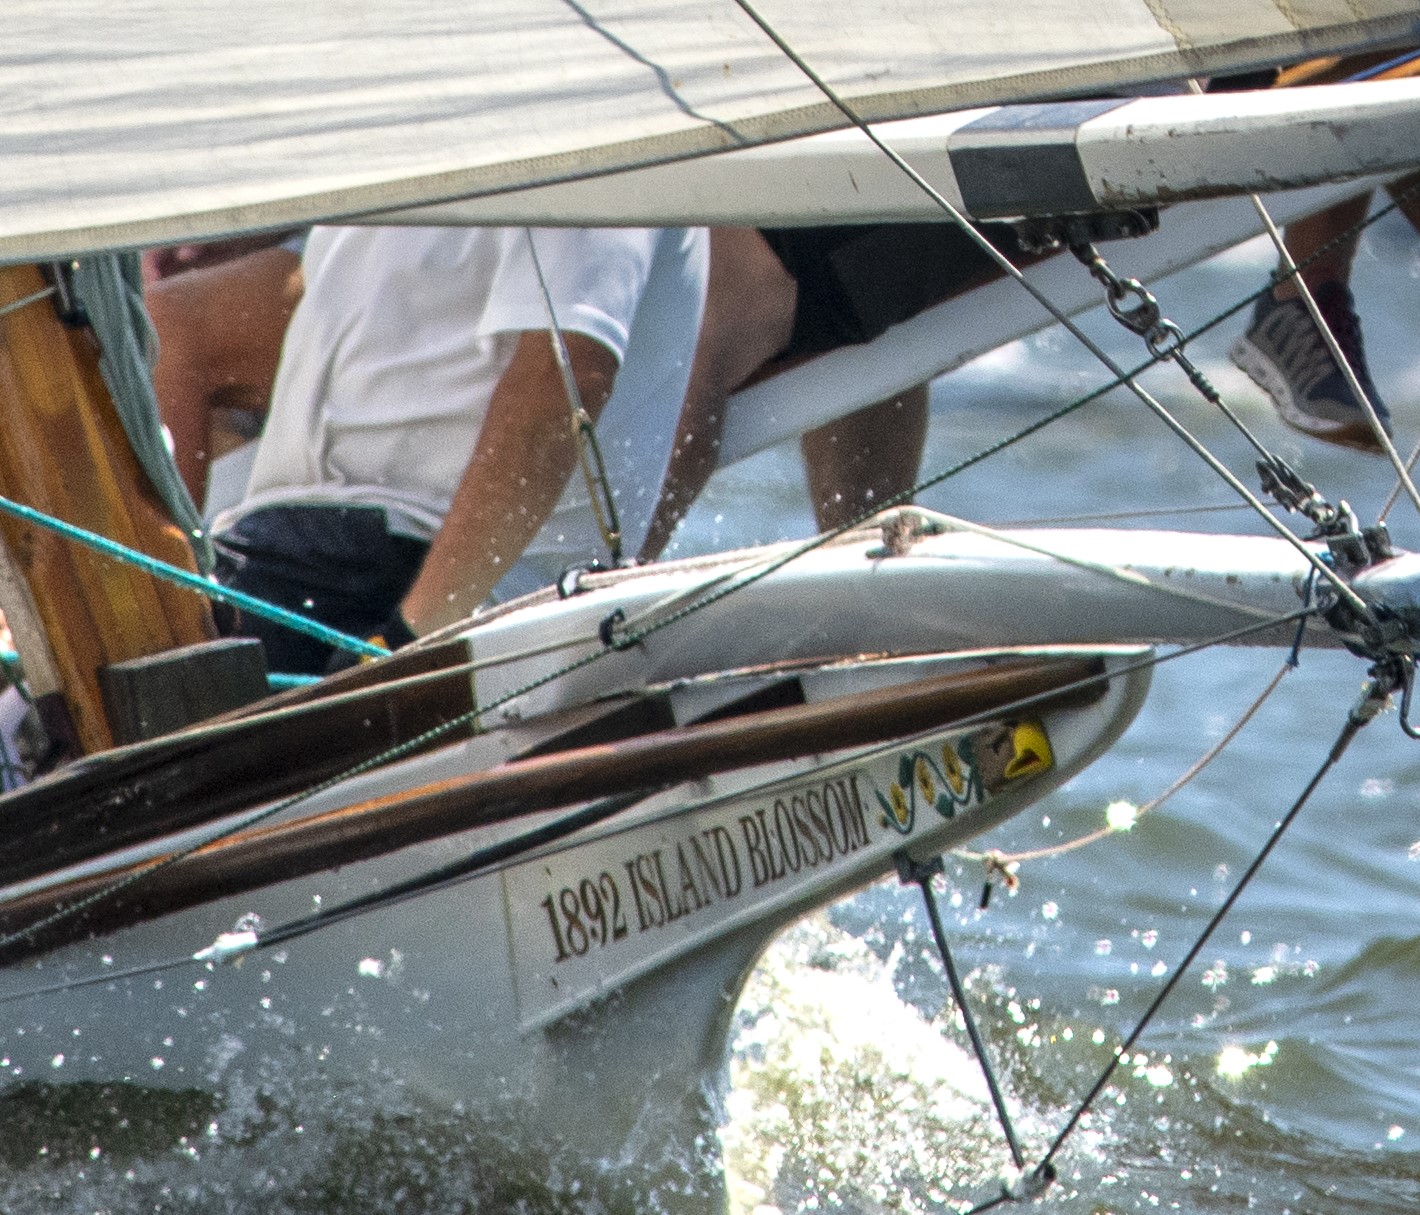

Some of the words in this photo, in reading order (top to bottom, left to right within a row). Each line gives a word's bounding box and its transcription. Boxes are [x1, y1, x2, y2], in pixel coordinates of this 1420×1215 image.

[541, 872, 628, 962] 1892
[625, 824, 743, 932] ISLAND
[738, 775, 872, 887] BLOSSOM
